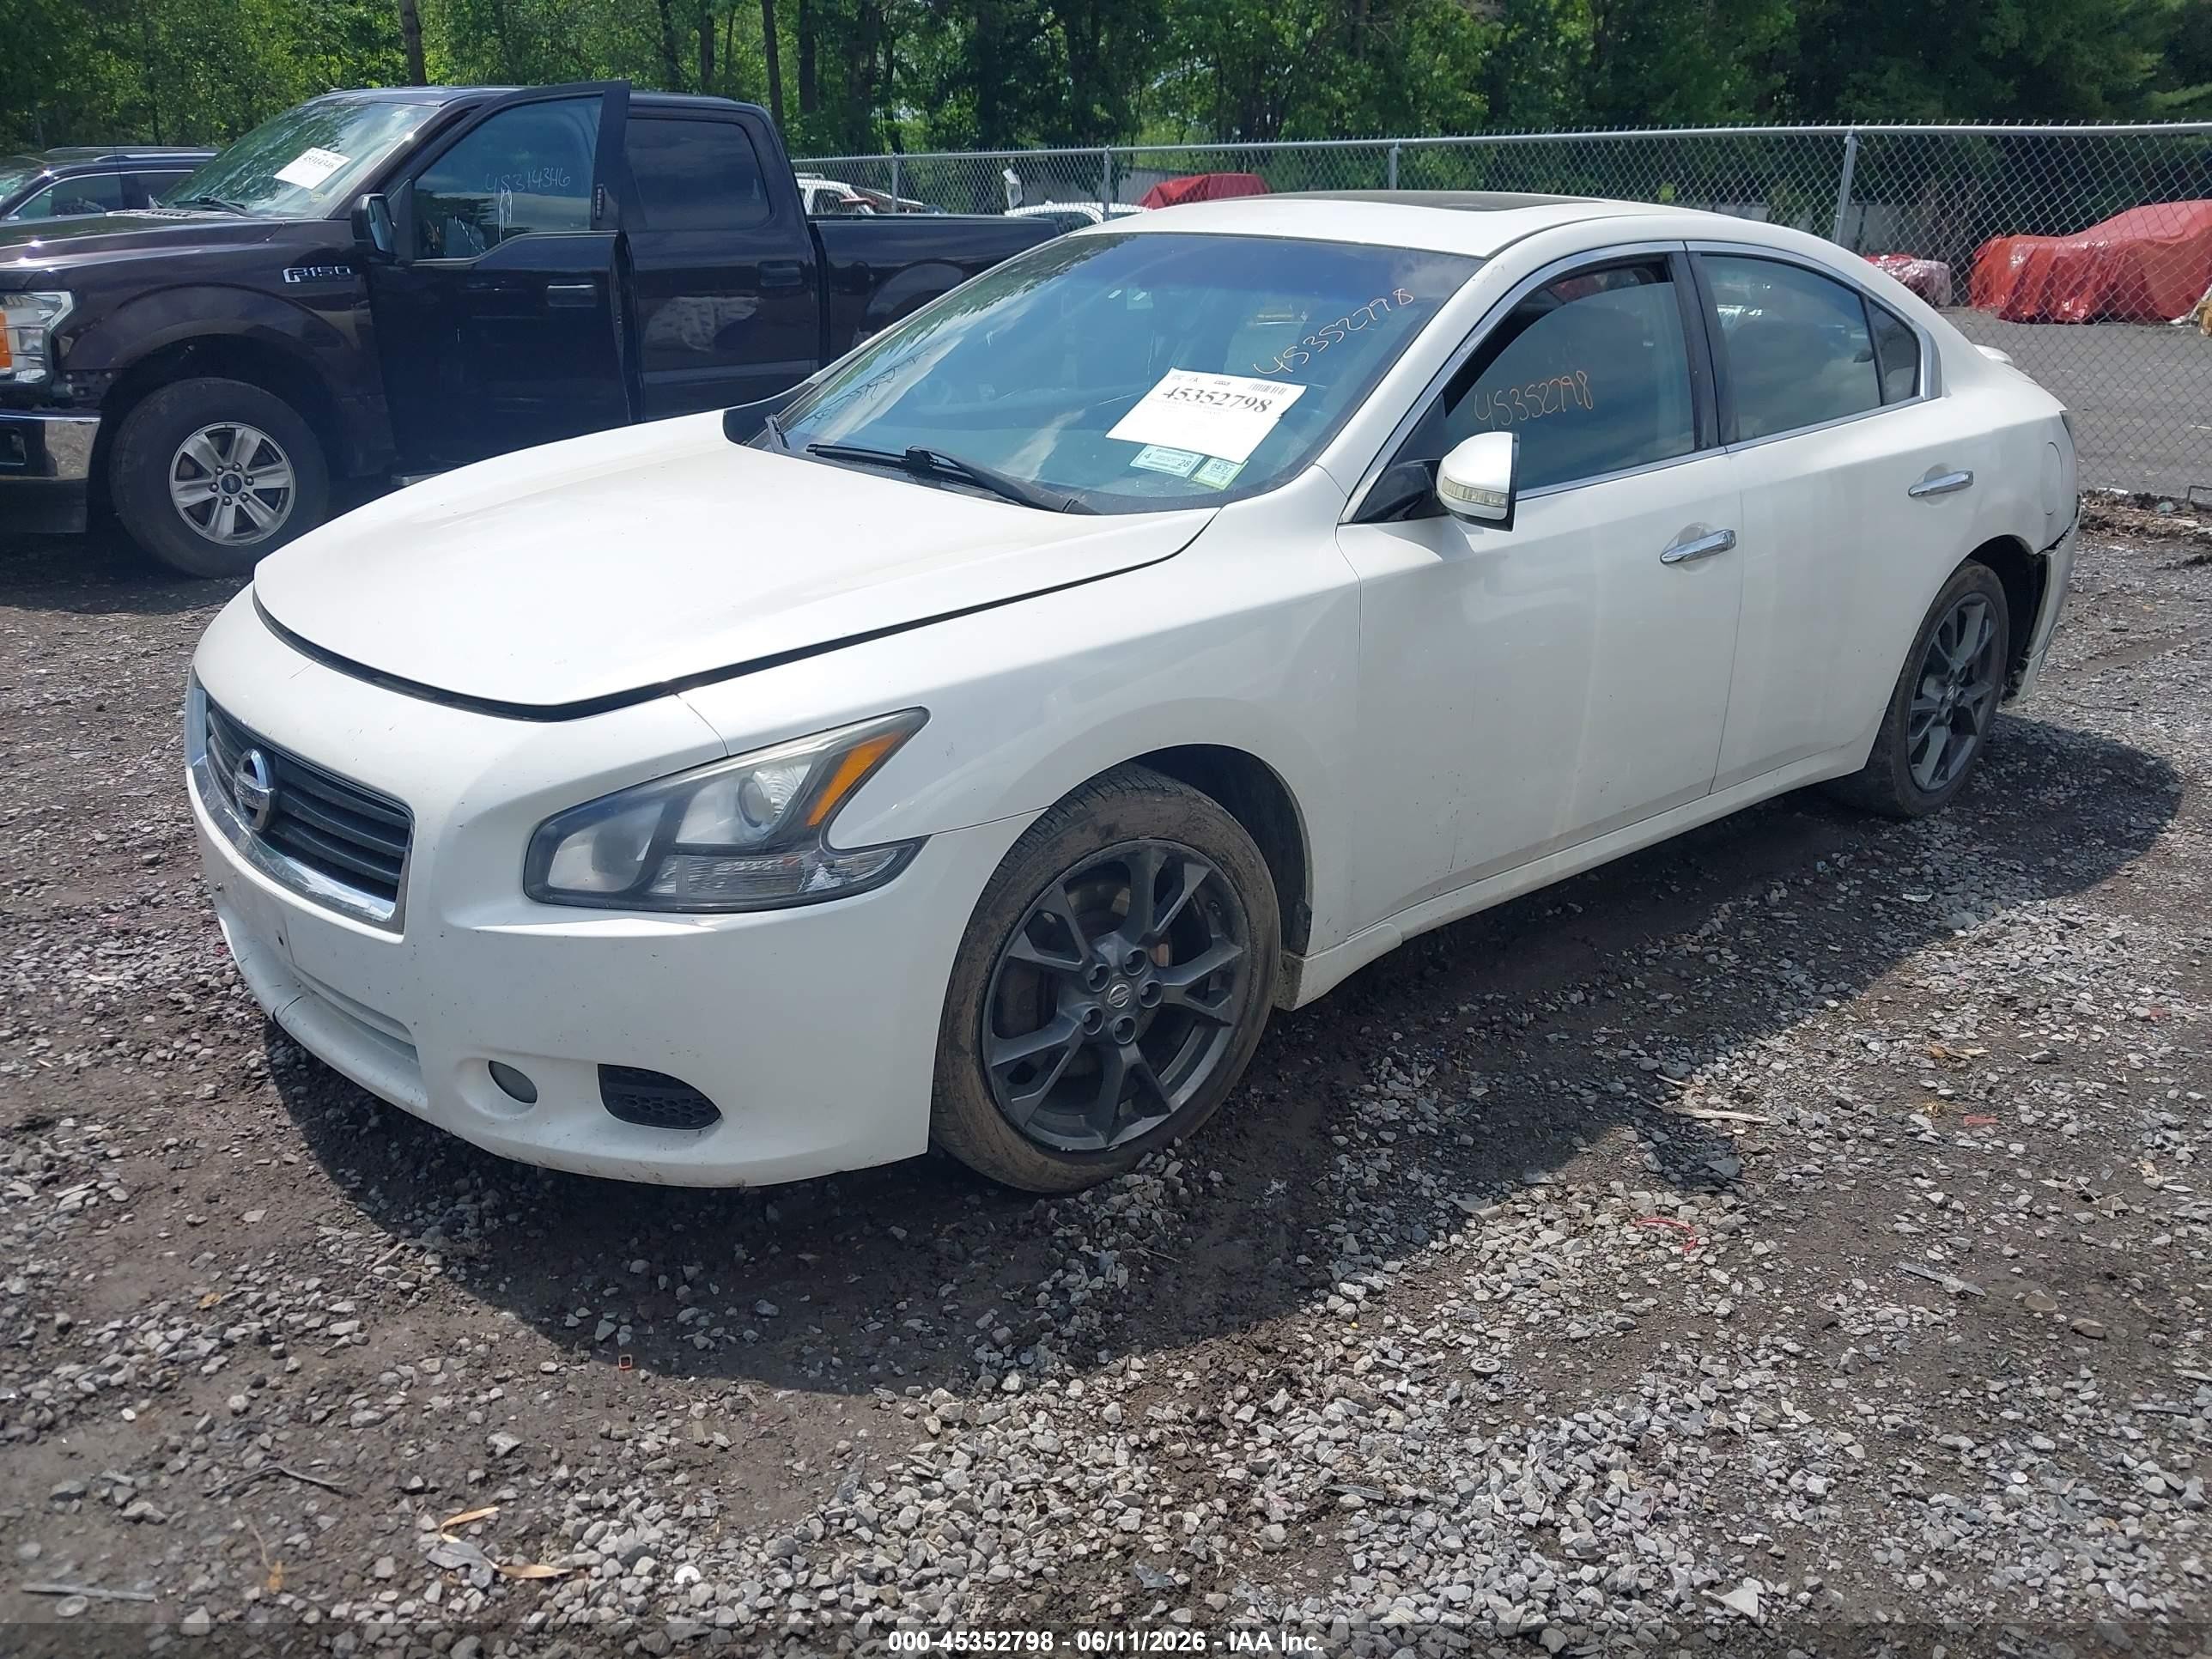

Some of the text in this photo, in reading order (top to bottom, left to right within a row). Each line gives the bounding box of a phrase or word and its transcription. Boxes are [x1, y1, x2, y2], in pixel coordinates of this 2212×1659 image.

[485, 167, 571, 198] 45314346
[1253, 289, 1414, 374] 45352798
[1163, 386, 1273, 413] 45352798
[1474, 370, 1594, 430] 45352798
